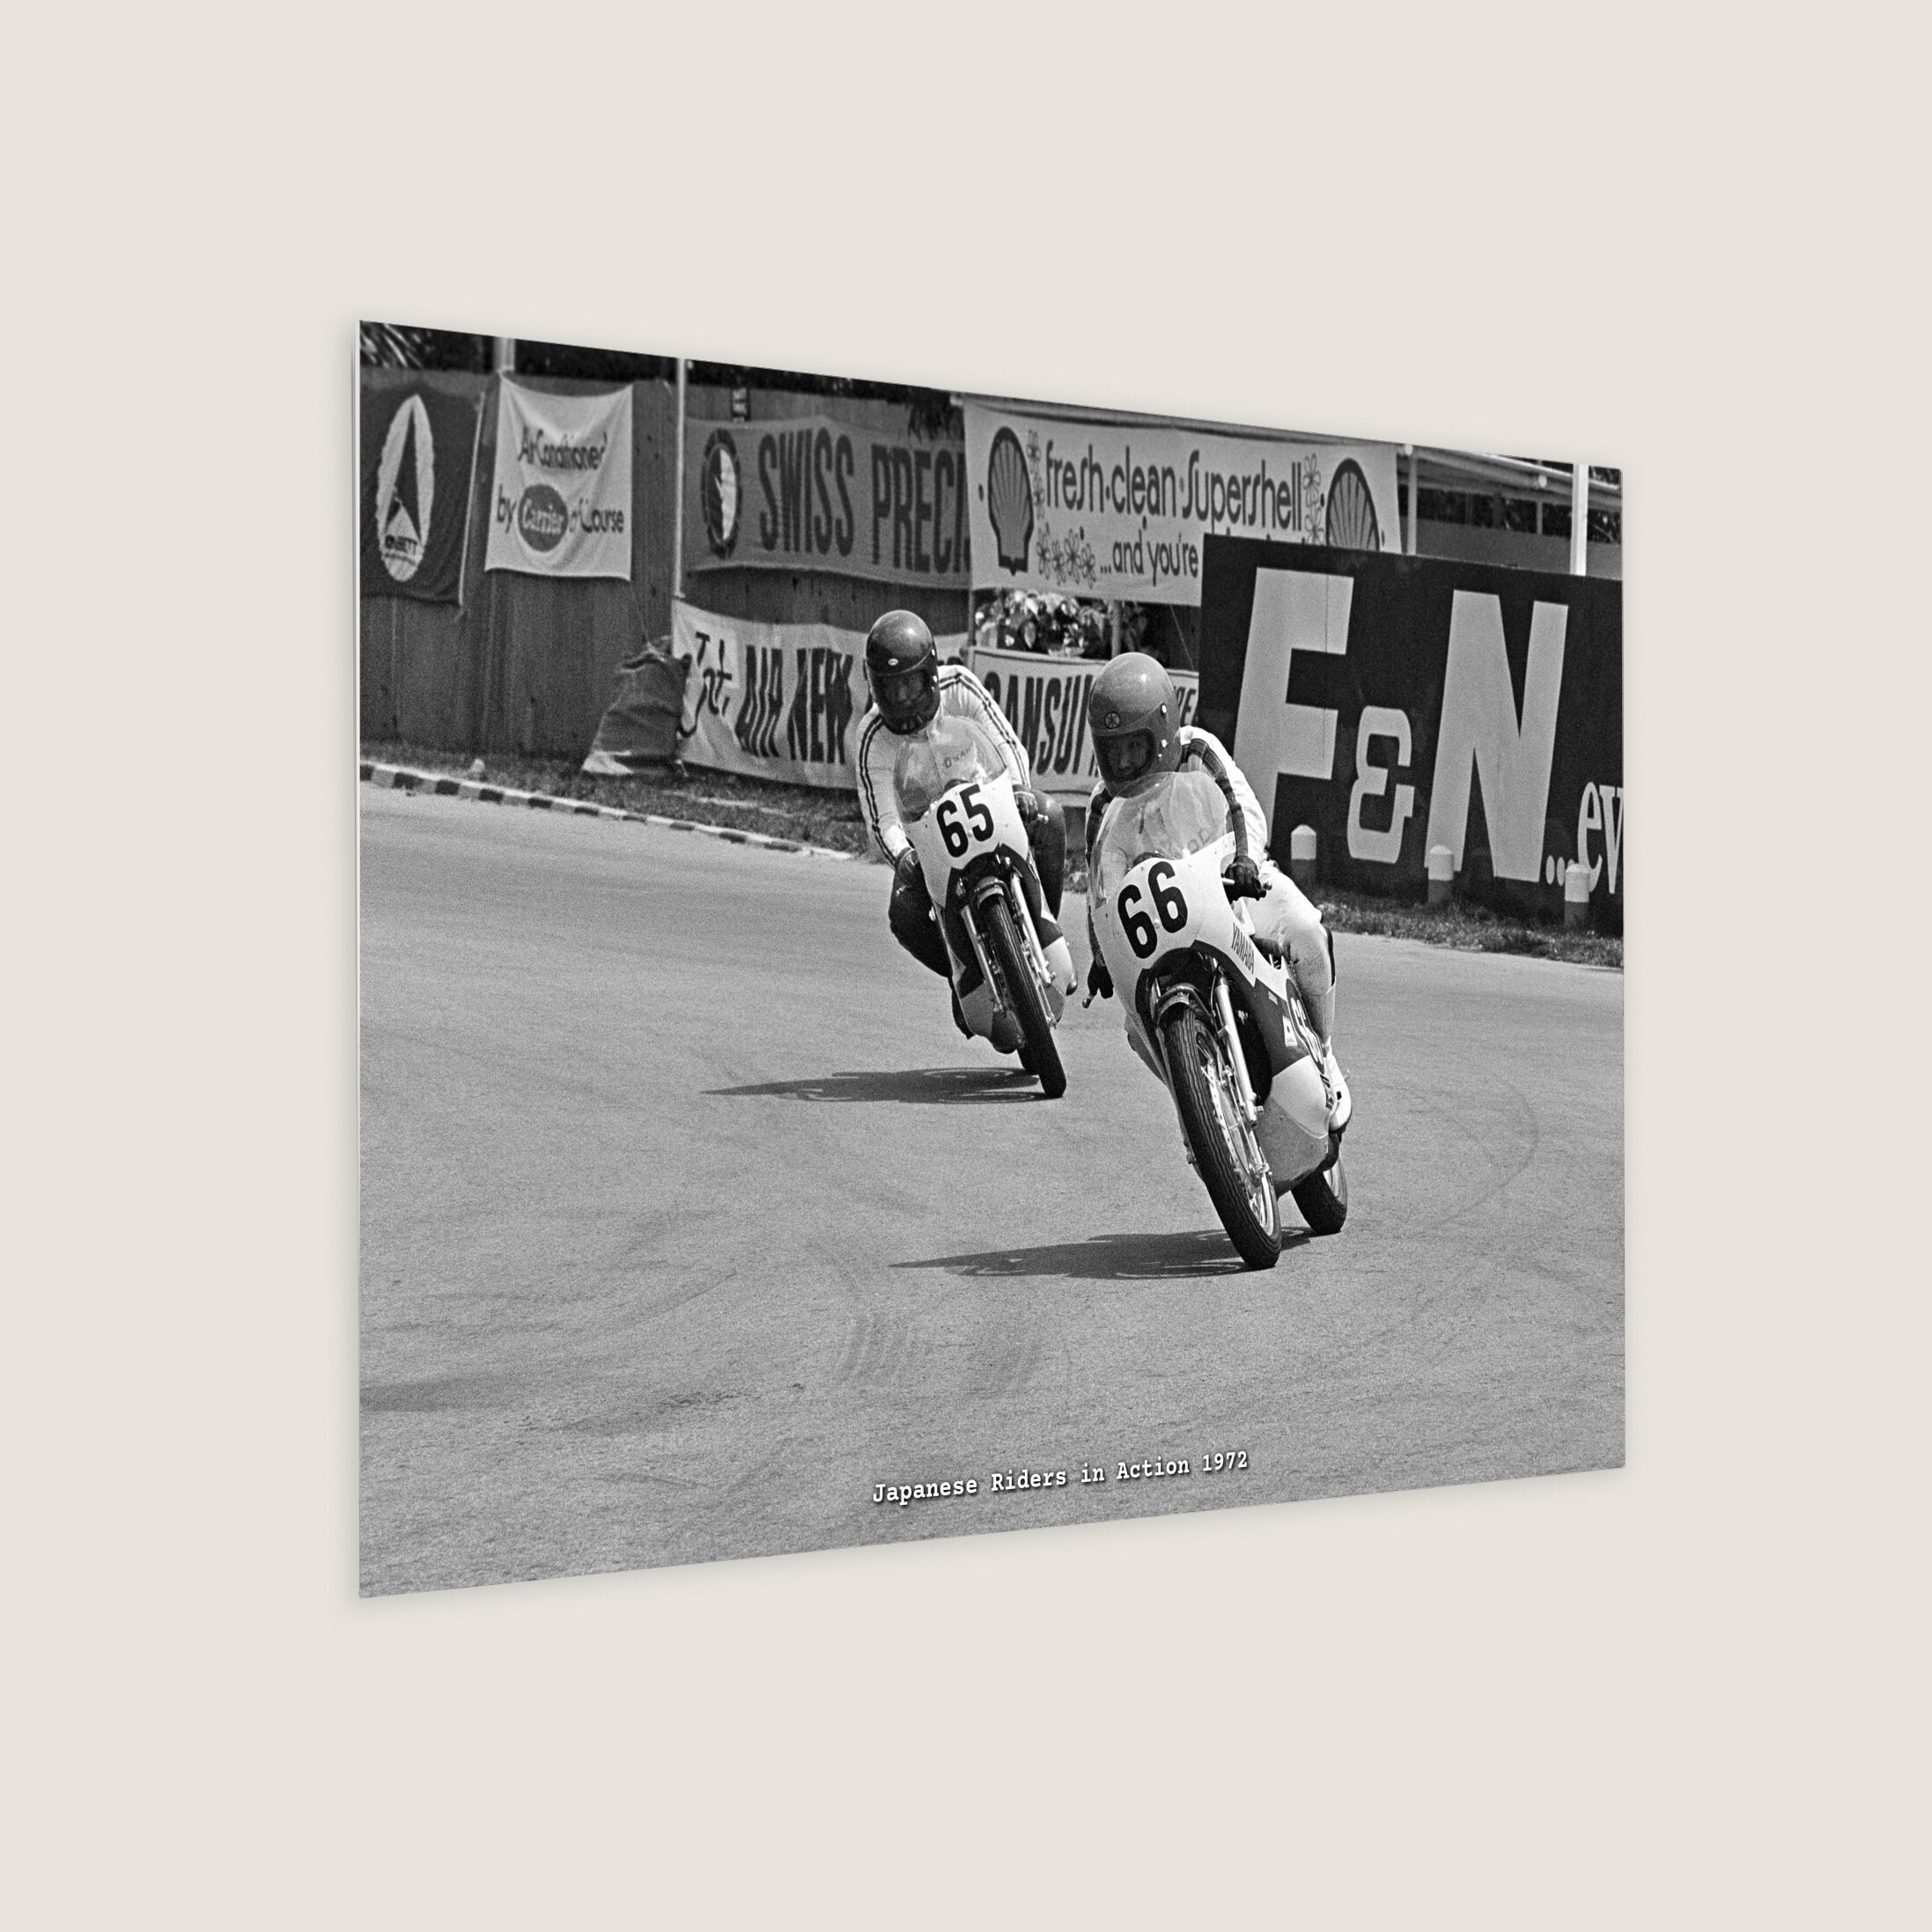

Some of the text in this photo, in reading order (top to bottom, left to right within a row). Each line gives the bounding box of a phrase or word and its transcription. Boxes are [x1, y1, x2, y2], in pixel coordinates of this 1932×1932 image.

[497, 483, 518, 534] by
[758, 427, 854, 557] SWISS
[1182, 449, 1302, 535] Supershell
[1147, 532, 1198, 587] you're
[734, 645, 783, 758] AIR
[786, 647, 854, 765] NEW
[936, 783, 995, 859] 65
[1117, 860, 1189, 960] 66
[1231, 922, 1255, 975] YAMAHA
